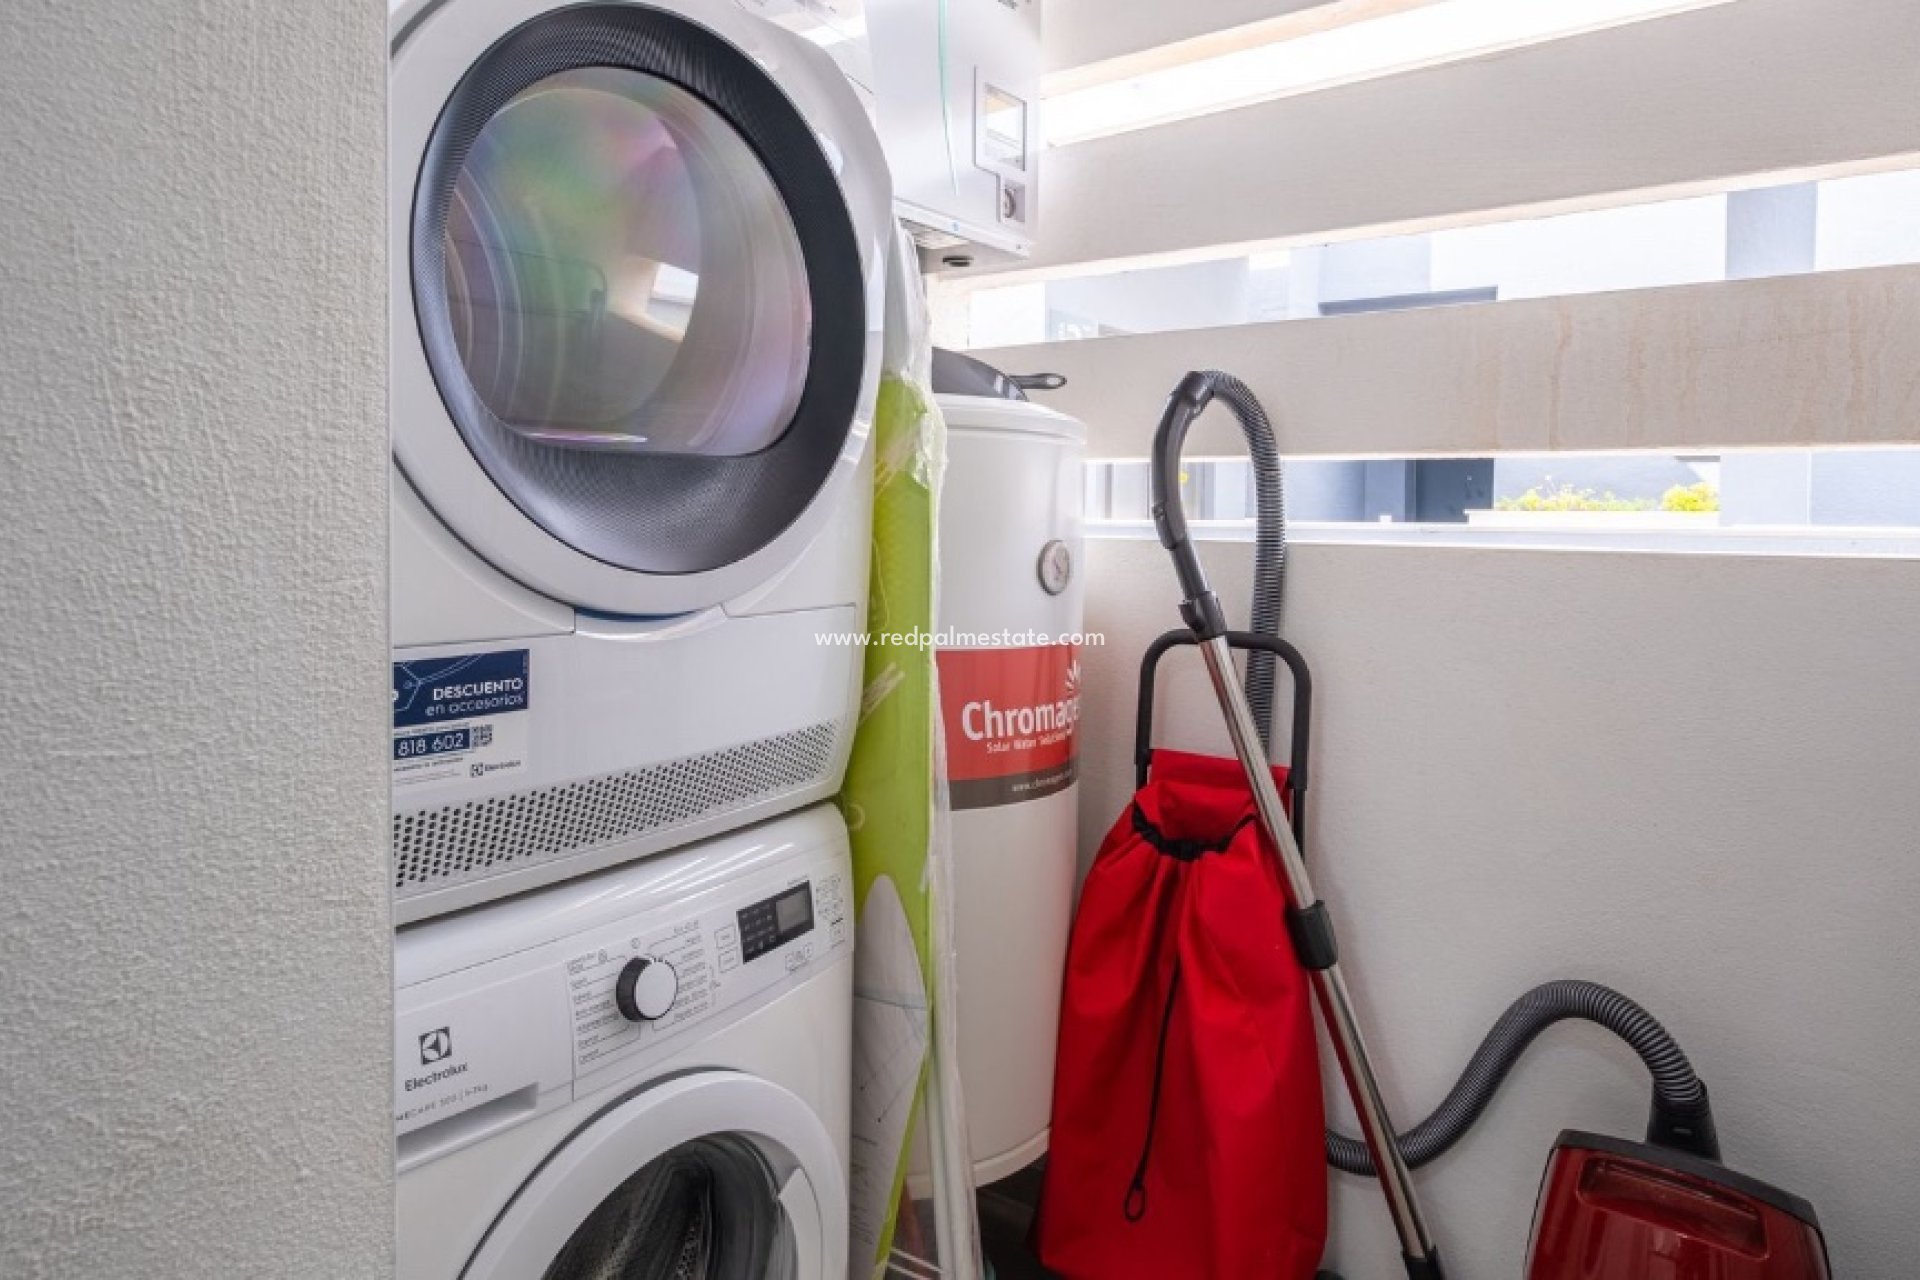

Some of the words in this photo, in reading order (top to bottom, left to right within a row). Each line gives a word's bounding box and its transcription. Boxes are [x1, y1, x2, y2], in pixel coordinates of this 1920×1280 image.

[433, 677, 524, 701] DESCUENTO
[425, 702, 446, 717] en
[449, 693, 524, 714] accesorios
[398, 738, 426, 757] 818
[432, 732, 464, 751] 602
[405, 1061, 468, 1092] Electrolux
